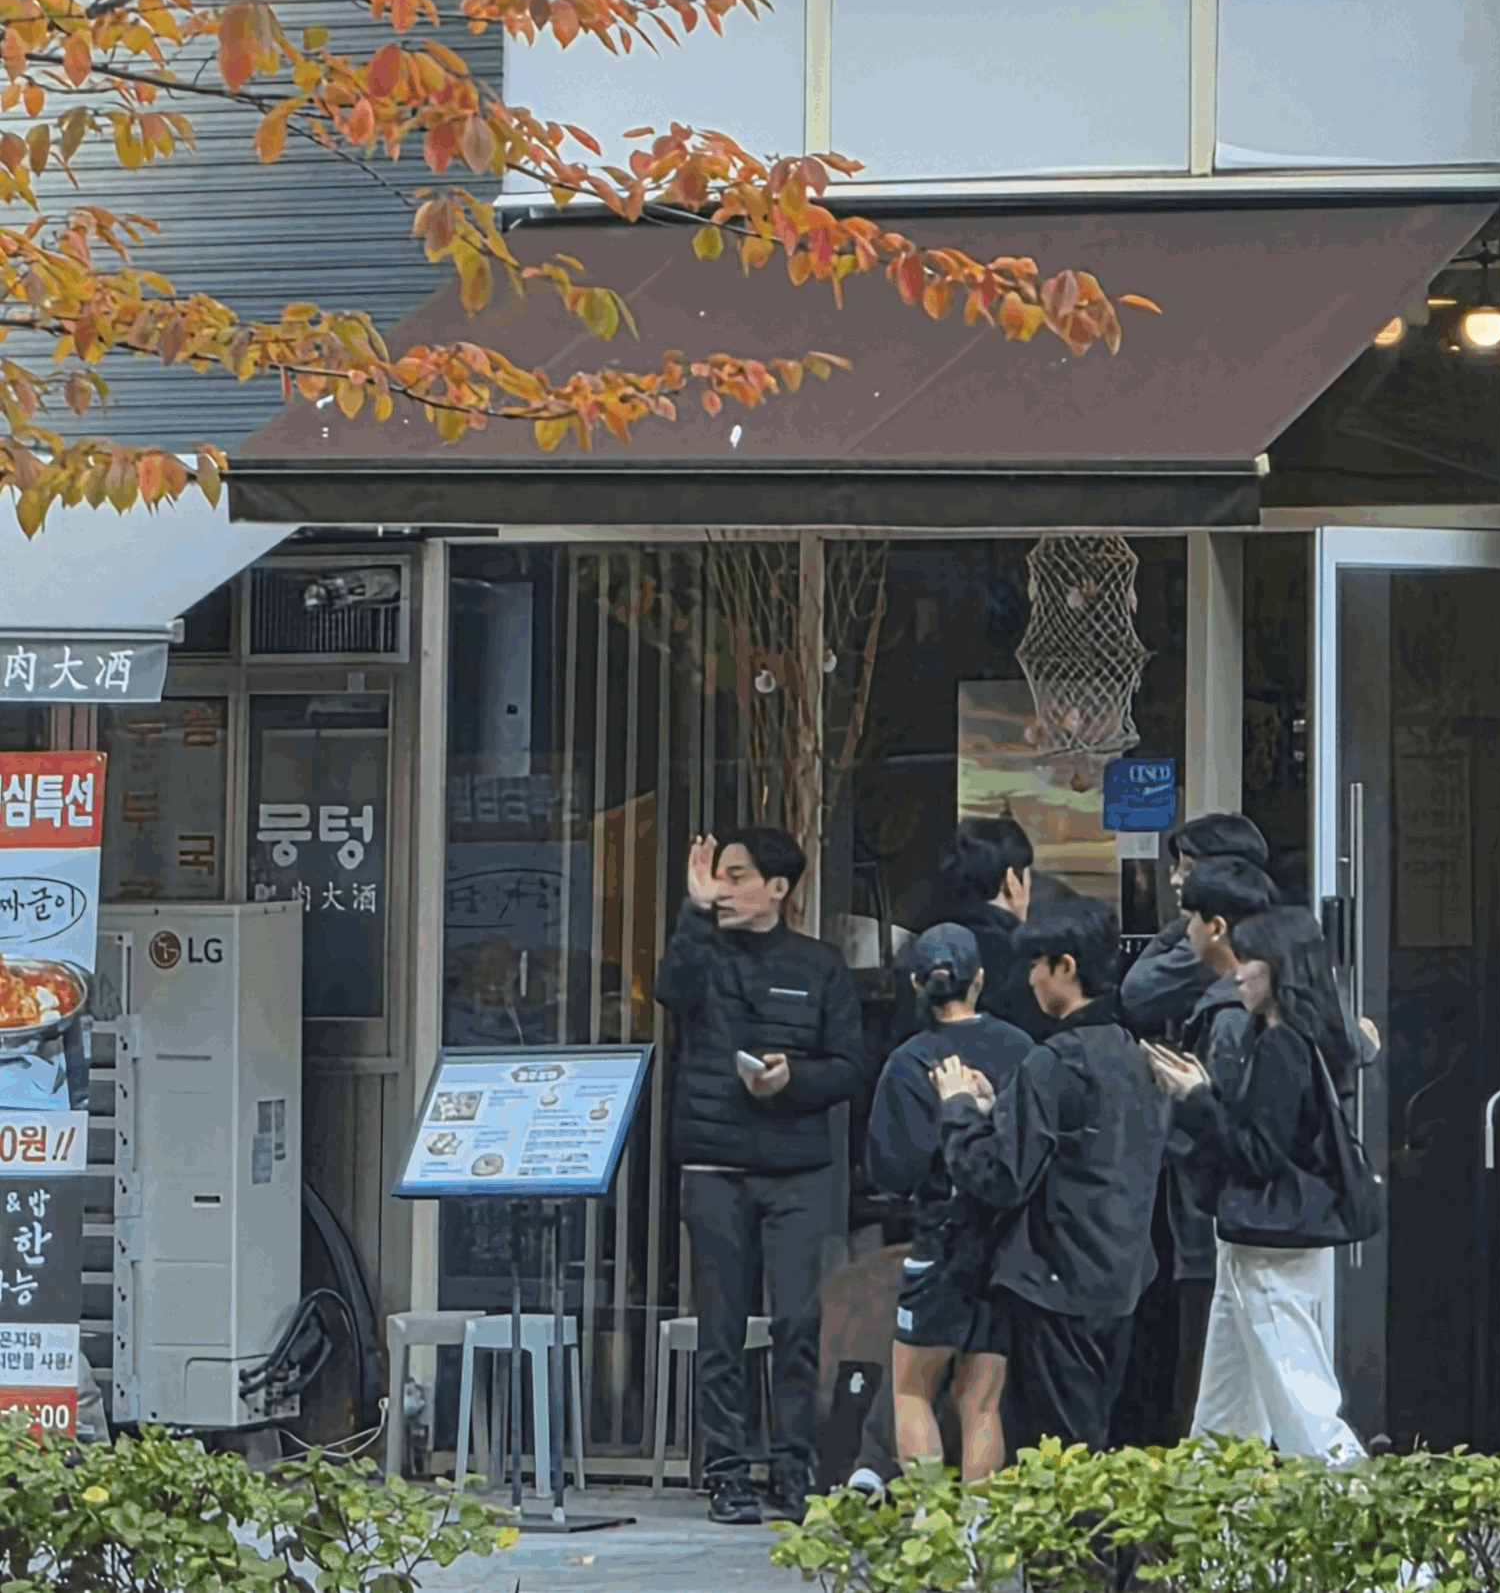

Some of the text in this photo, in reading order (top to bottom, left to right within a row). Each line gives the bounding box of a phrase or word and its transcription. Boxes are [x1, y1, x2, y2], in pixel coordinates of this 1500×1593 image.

[0, 773, 94, 827] 심특선
[188, 938, 223, 963] LG
[0, 1125, 76, 1163] 0원!!
[6, 1188, 51, 1218] & 밥
